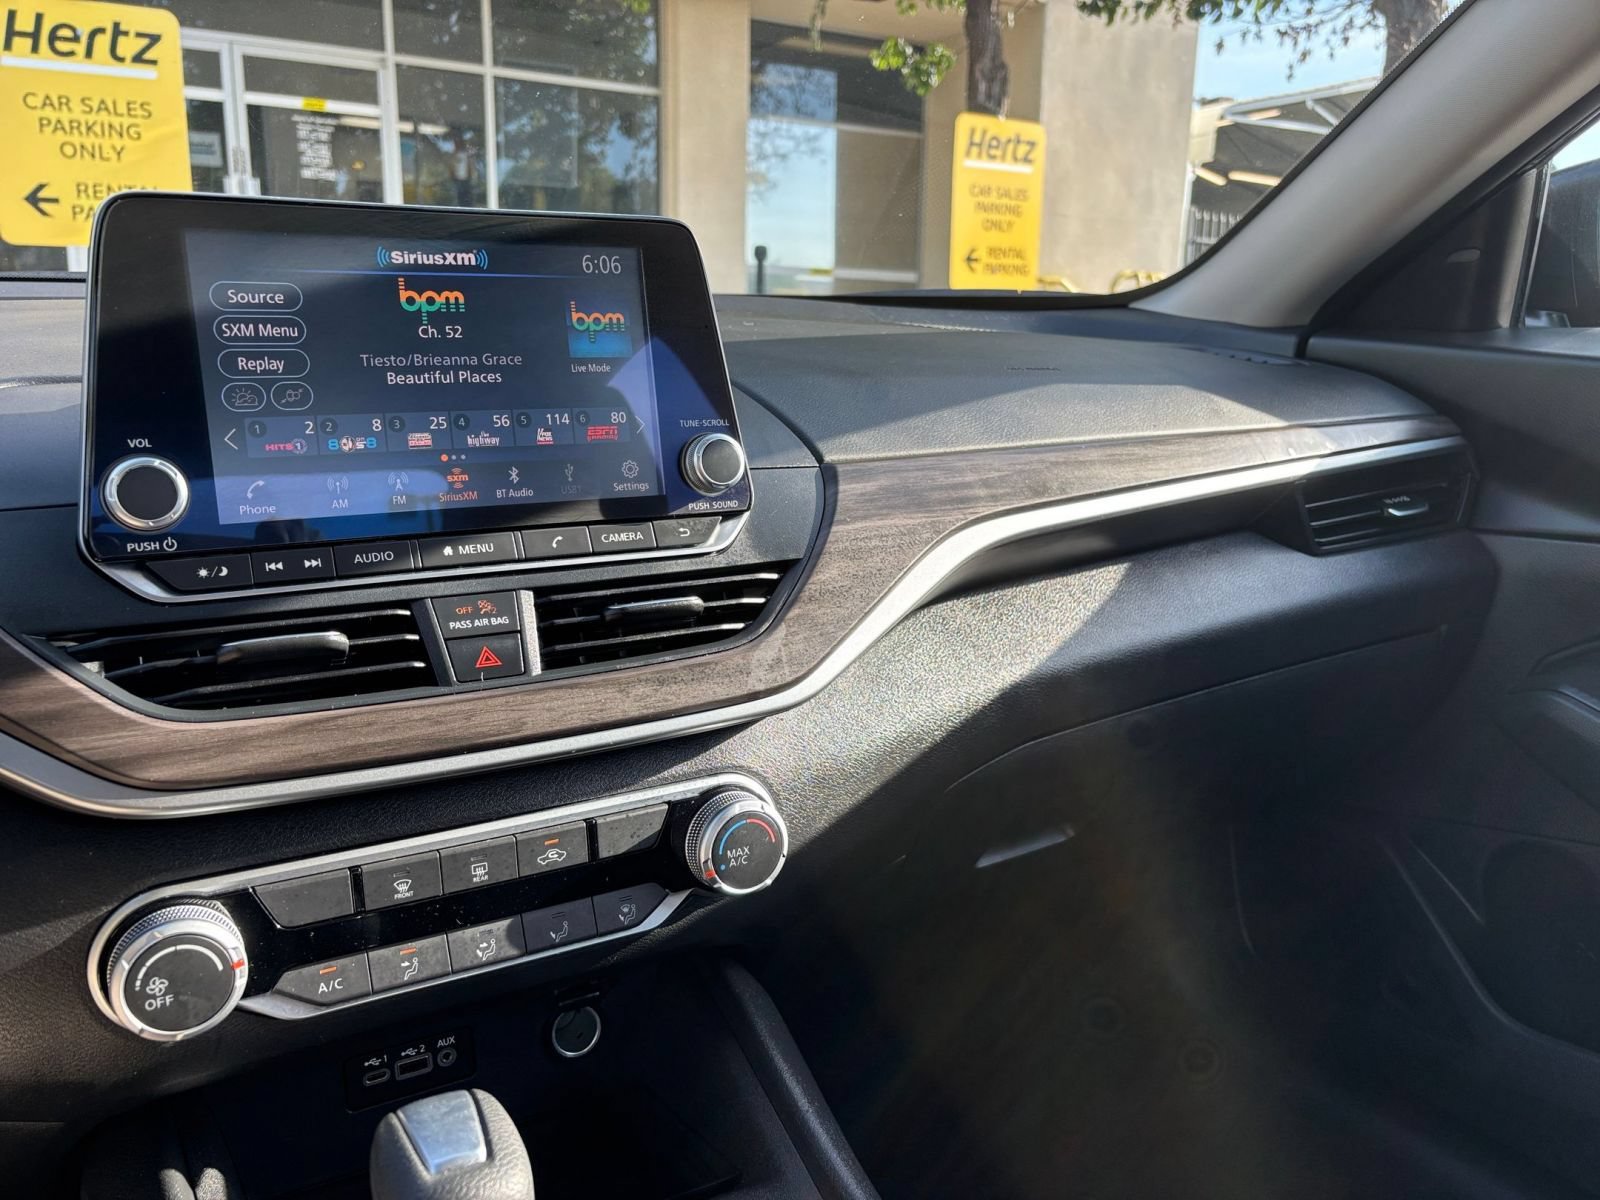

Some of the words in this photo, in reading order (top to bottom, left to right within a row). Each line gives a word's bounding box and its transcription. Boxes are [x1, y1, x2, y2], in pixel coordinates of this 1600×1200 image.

[3, 9, 163, 66] Hertz
[22, 92, 73, 112] CAR
[80, 96, 153, 119] SALES
[38, 117, 142, 140] PARKING
[965, 127, 1038, 163] Hertz
[59, 141, 126, 163] ONLY
[969, 183, 993, 198] CAR
[582, 254, 622, 275] 6:06
[227, 289, 284, 304] Source
[398, 277, 465, 325] bpm
[570, 301, 626, 342] bpm
[221, 323, 255, 337] SXM
[258, 323, 299, 337] Menu
[418, 325, 442, 339] Ch.
[445, 326, 463, 338] 52
[237, 357, 285, 374] Replay
[360, 354, 478, 368] Tiesto/Brieanna
[482, 354, 523, 367] Grace
[571, 363, 587, 373] Live
[588, 363, 612, 373] Mode
[387, 371, 455, 385] Beautiful
[458, 370, 503, 384] Places
[429, 416, 447, 430] 25
[493, 414, 510, 427] 56
[546, 413, 570, 425] 114
[610, 411, 627, 424] 80
[304, 421, 315, 435] 2
[372, 419, 382, 431] 8
[127, 438, 152, 448] VOL
[467, 434, 500, 447] highway
[496, 489, 506, 498] BT
[508, 487, 534, 498] Audio
[613, 482, 650, 492] Settings
[392, 495, 407, 505] FM
[439, 491, 478, 502] SiriusXM
[239, 505, 277, 516] Phone
[332, 500, 349, 509] AM
[688, 502, 710, 510] PUSH
[712, 500, 738, 509] SOUND
[601, 531, 644, 544] CAMERA
[127, 541, 160, 552] PUSH
[459, 543, 494, 555] MENU
[354, 551, 394, 564] AUDIO
[456, 606, 473, 614] OFF
[449, 620, 472, 630] PASS
[474, 617, 489, 627] AIR
[490, 616, 509, 626] BAG
[727, 846, 750, 858] MAX
[729, 855, 748, 868] A/C
[394, 890, 414, 900] FRONT
[318, 977, 344, 994] A/C
[145, 994, 174, 1011] OFF
[437, 1036, 456, 1048] AUX
